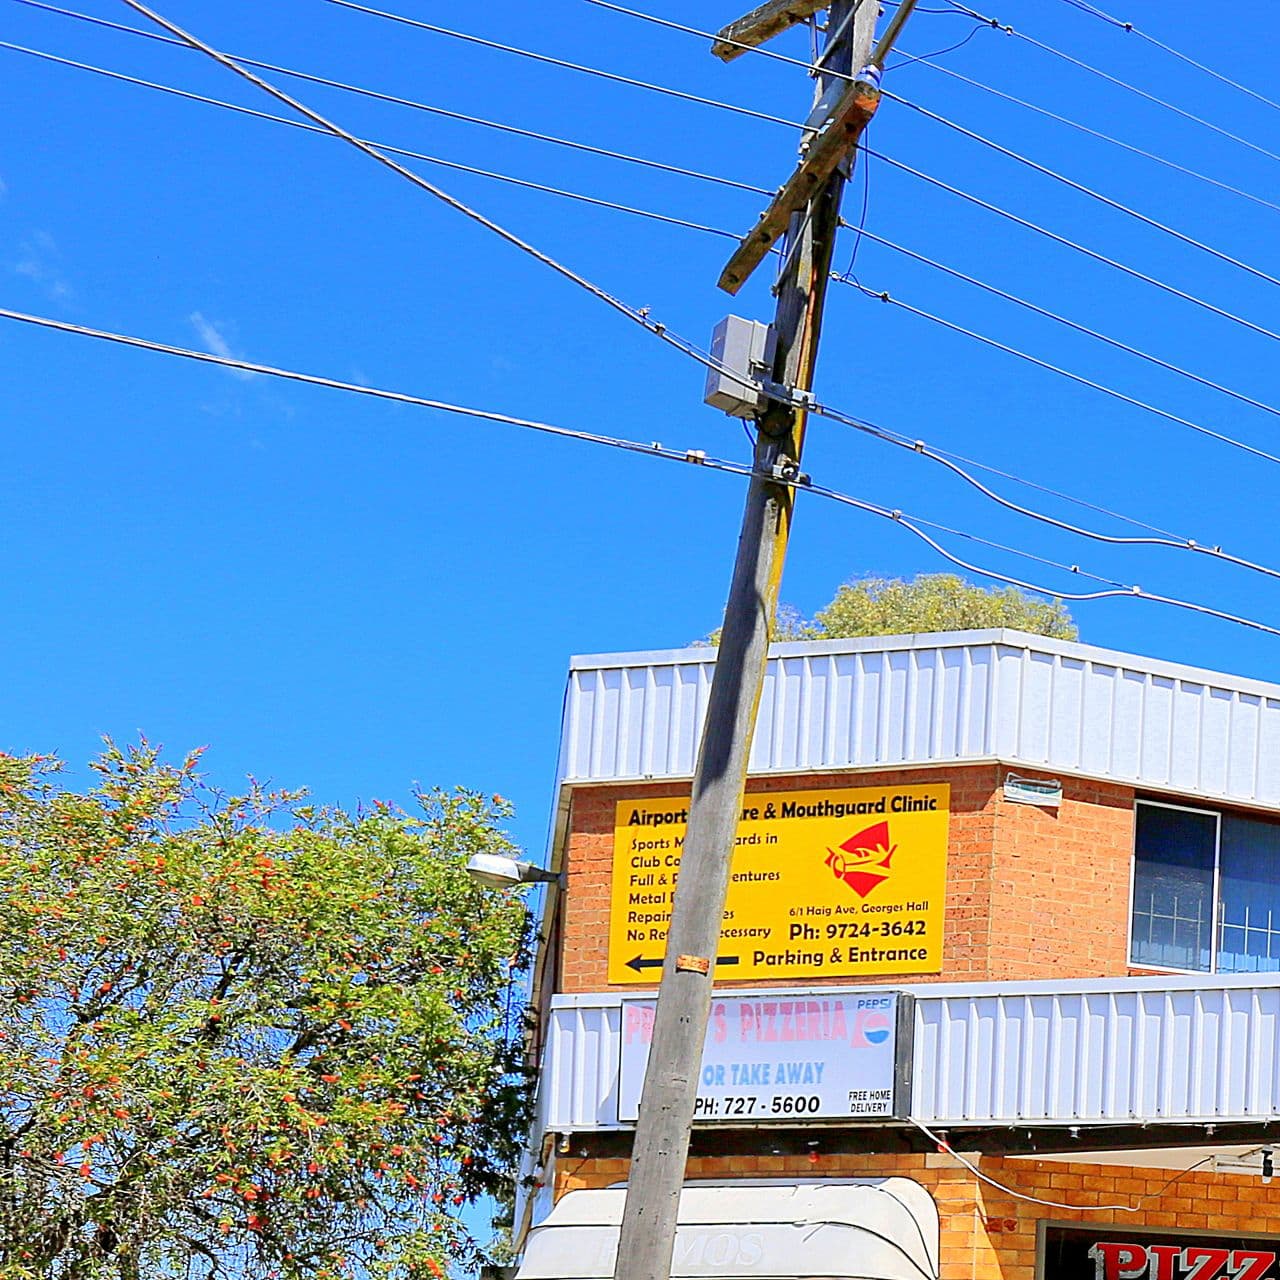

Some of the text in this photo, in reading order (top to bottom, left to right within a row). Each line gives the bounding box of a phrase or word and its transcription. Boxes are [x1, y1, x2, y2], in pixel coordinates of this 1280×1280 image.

[629, 808, 688, 828] Airport
[764, 803, 776, 819] &
[781, 797, 886, 818] Mouthguard
[891, 794, 937, 812] Clinic
[631, 837, 670, 853] Sports
[765, 833, 778, 844] in
[630, 856, 660, 868] Club
[630, 875, 654, 886] Full
[658, 873, 668, 885] &
[732, 871, 780, 882] entures
[629, 892, 666, 904] Metal
[628, 910, 672, 924] Repair
[789, 900, 929, 917] 6/1 Haig Ave, Georges Hall
[627, 929, 645, 942] No
[719, 927, 772, 940] ecessary
[789, 920, 927, 940] Ph: 9724-3642
[753, 946, 928, 967] Parking & Entrance
[739, 1000, 849, 1042] PIZZERIA
[703, 1062, 825, 1087] OR TAKE AWAY
[848, 1090, 891, 1102] FREE HOME
[694, 1096, 820, 1115] PH: 727 5600
[850, 1102, 888, 1114] DELIVERY
